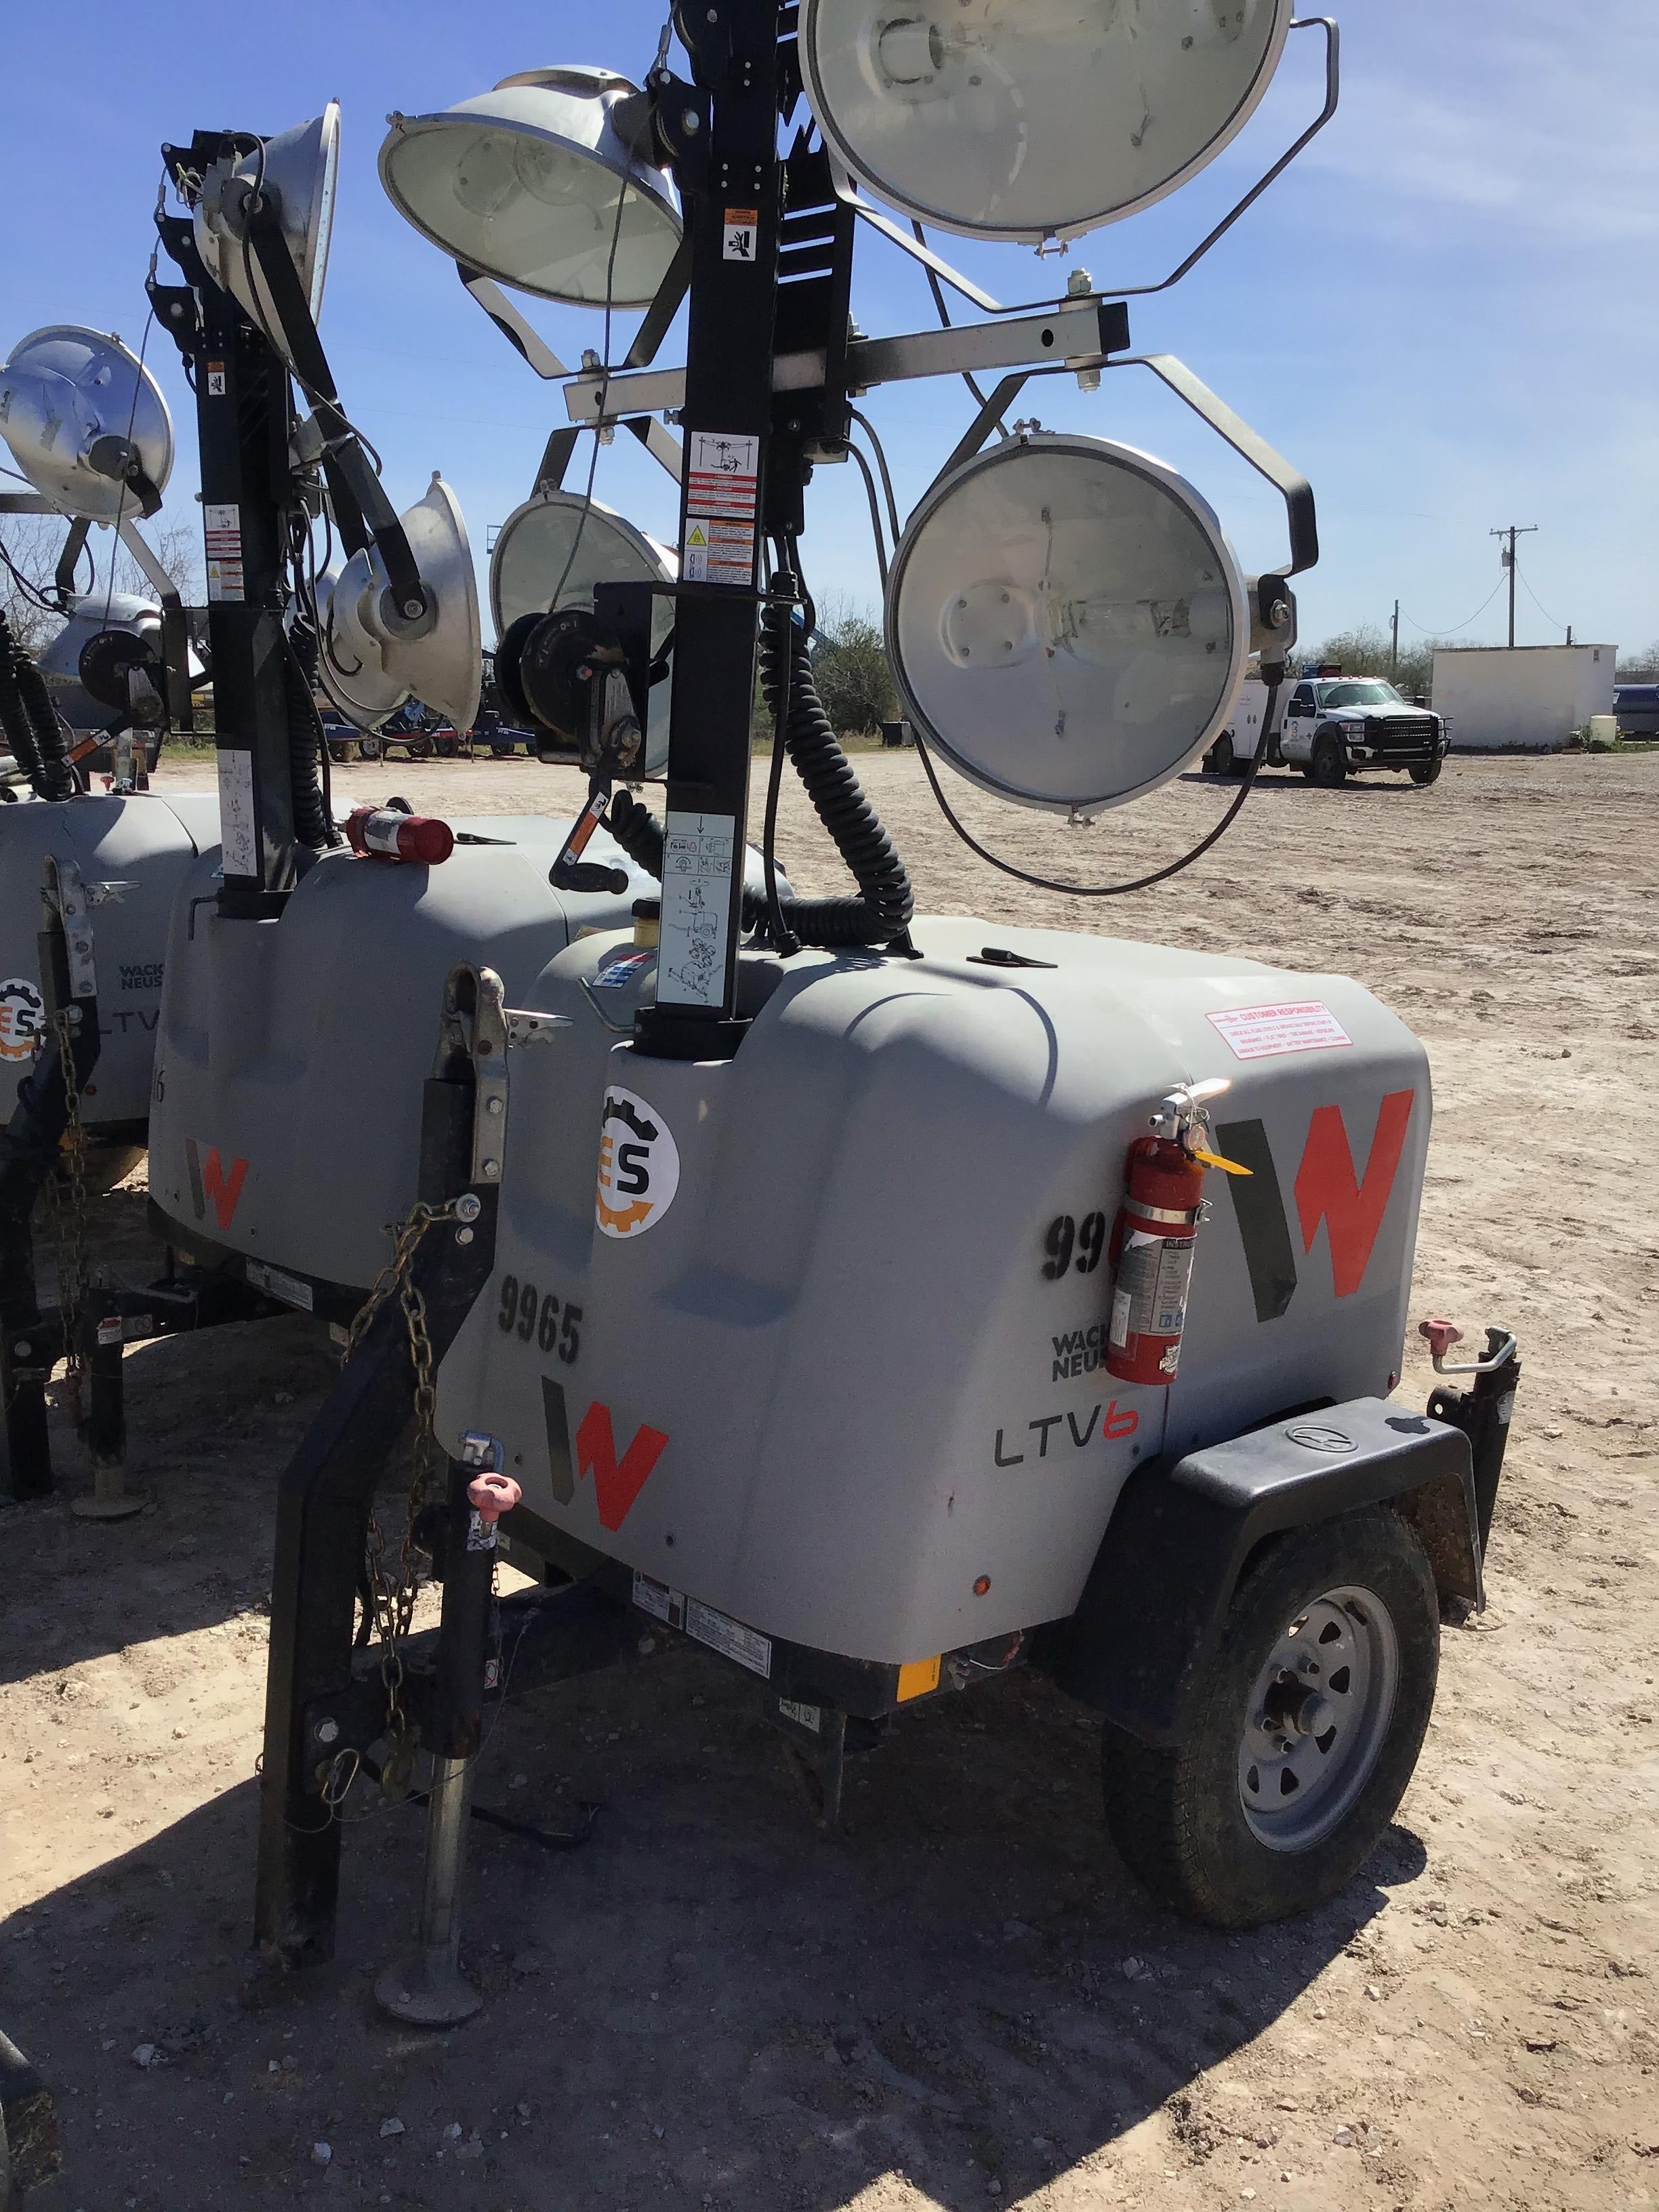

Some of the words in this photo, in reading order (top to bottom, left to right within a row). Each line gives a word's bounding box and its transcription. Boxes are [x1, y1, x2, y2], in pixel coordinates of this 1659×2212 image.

[1240, 1009, 1277, 1021] CUSTOMER
[1277, 1005, 1327, 1016] RESPONSIBILITY
[497, 1273, 583, 1365] 9965
[994, 1400, 1139, 1467] LTV6
